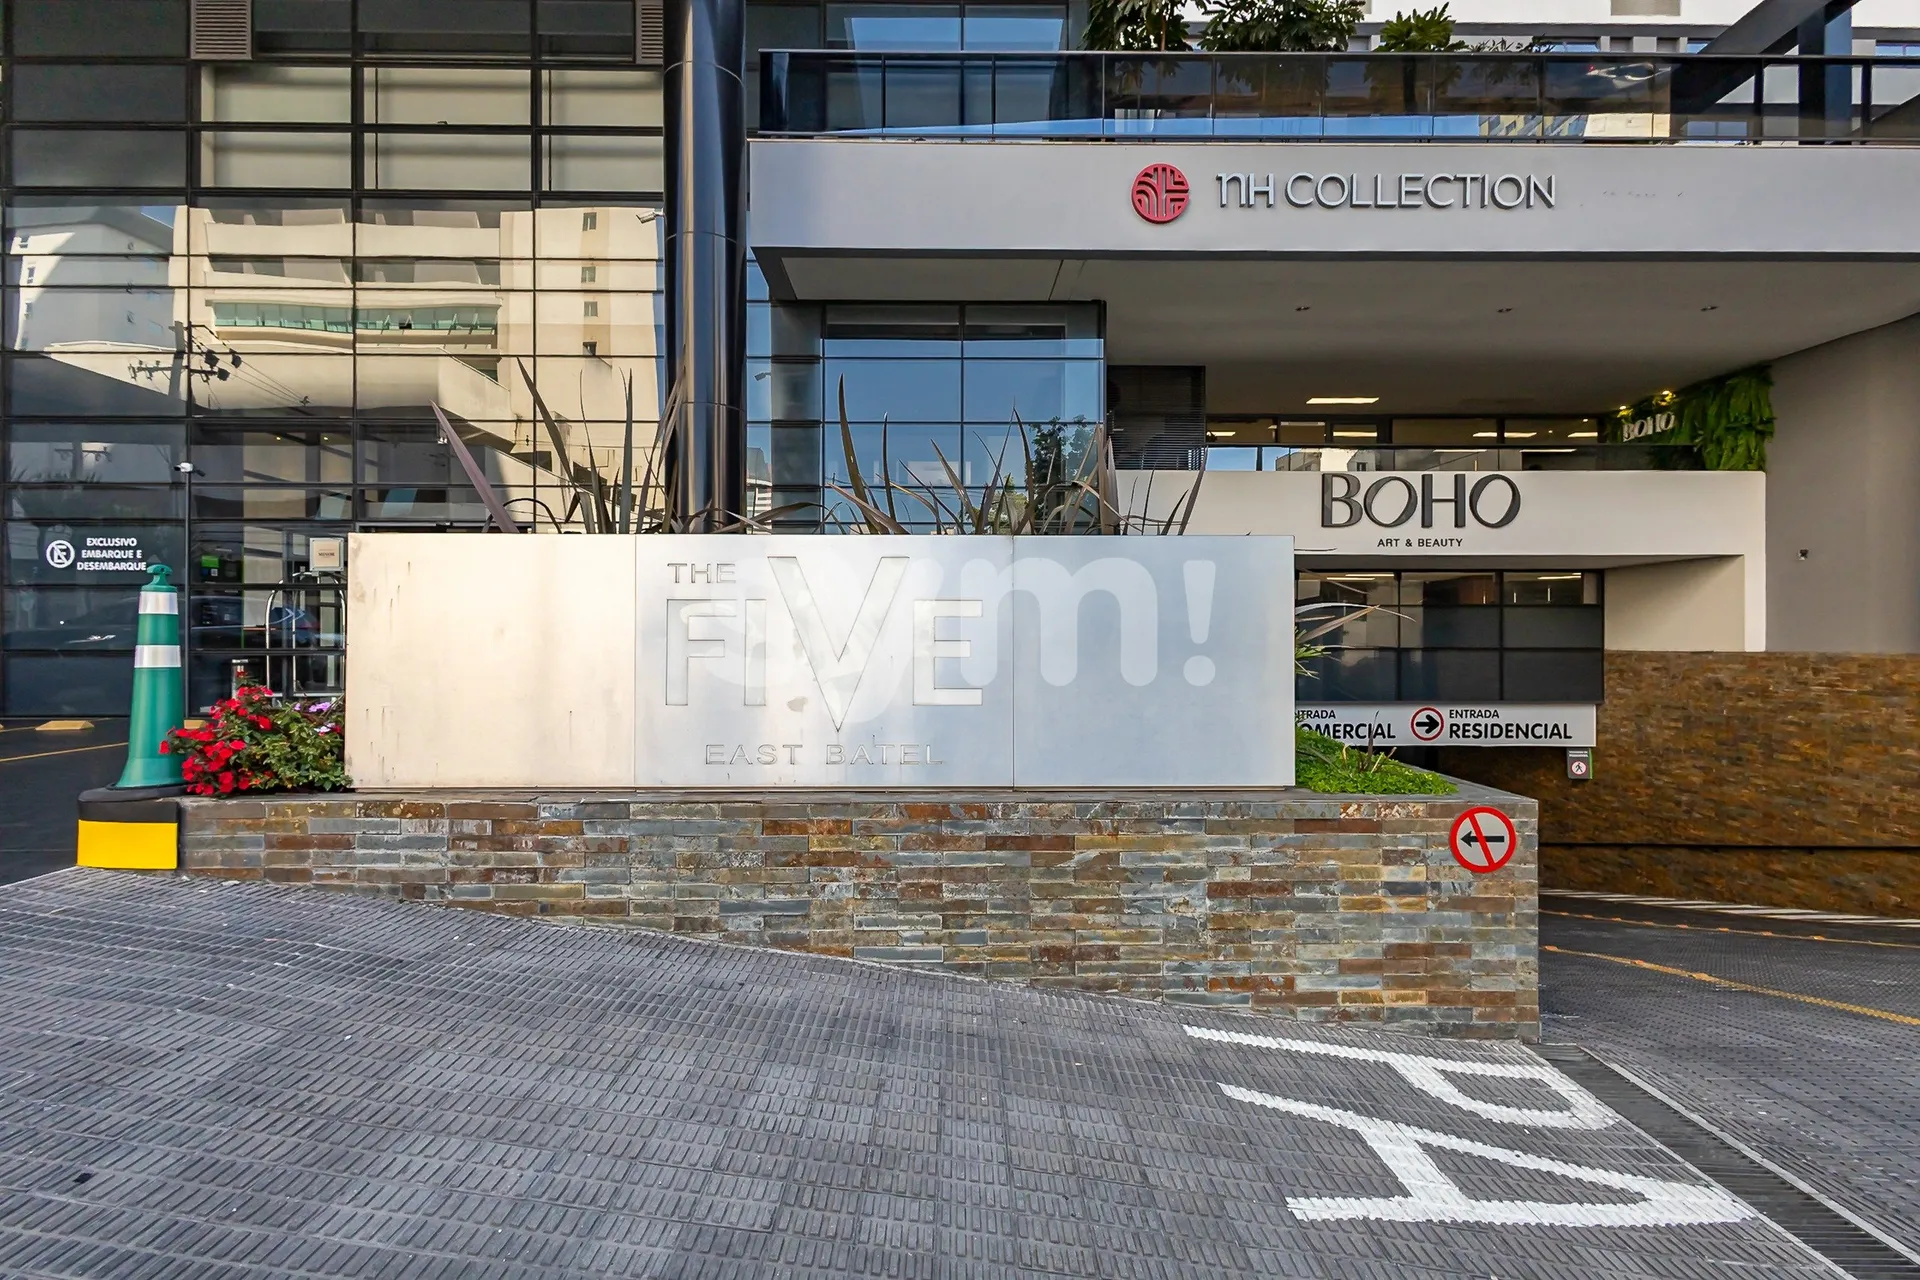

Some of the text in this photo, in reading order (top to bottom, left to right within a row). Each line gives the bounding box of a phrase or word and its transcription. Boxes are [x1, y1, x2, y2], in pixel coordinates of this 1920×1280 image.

[1284, 172, 1556, 210] COLLECTION
[1622, 411, 1676, 442] BOHO
[1321, 473, 1521, 528] BOHO
[86, 537, 137, 547] EXCLUSIVO
[1377, 538, 1463, 547] ART & BEAUTY
[81, 549, 142, 559] EMBARQUE E
[76, 562, 147, 571] DESEMBARQUE
[667, 563, 736, 584] THE
[666, 556, 983, 732] FIVE
[1449, 709, 1500, 719] ENTRADA
[1298, 722, 1396, 739] OMERCIAL
[1449, 722, 1573, 739] RESIDENCIAL
[705, 744, 943, 765] EAST BATEL
